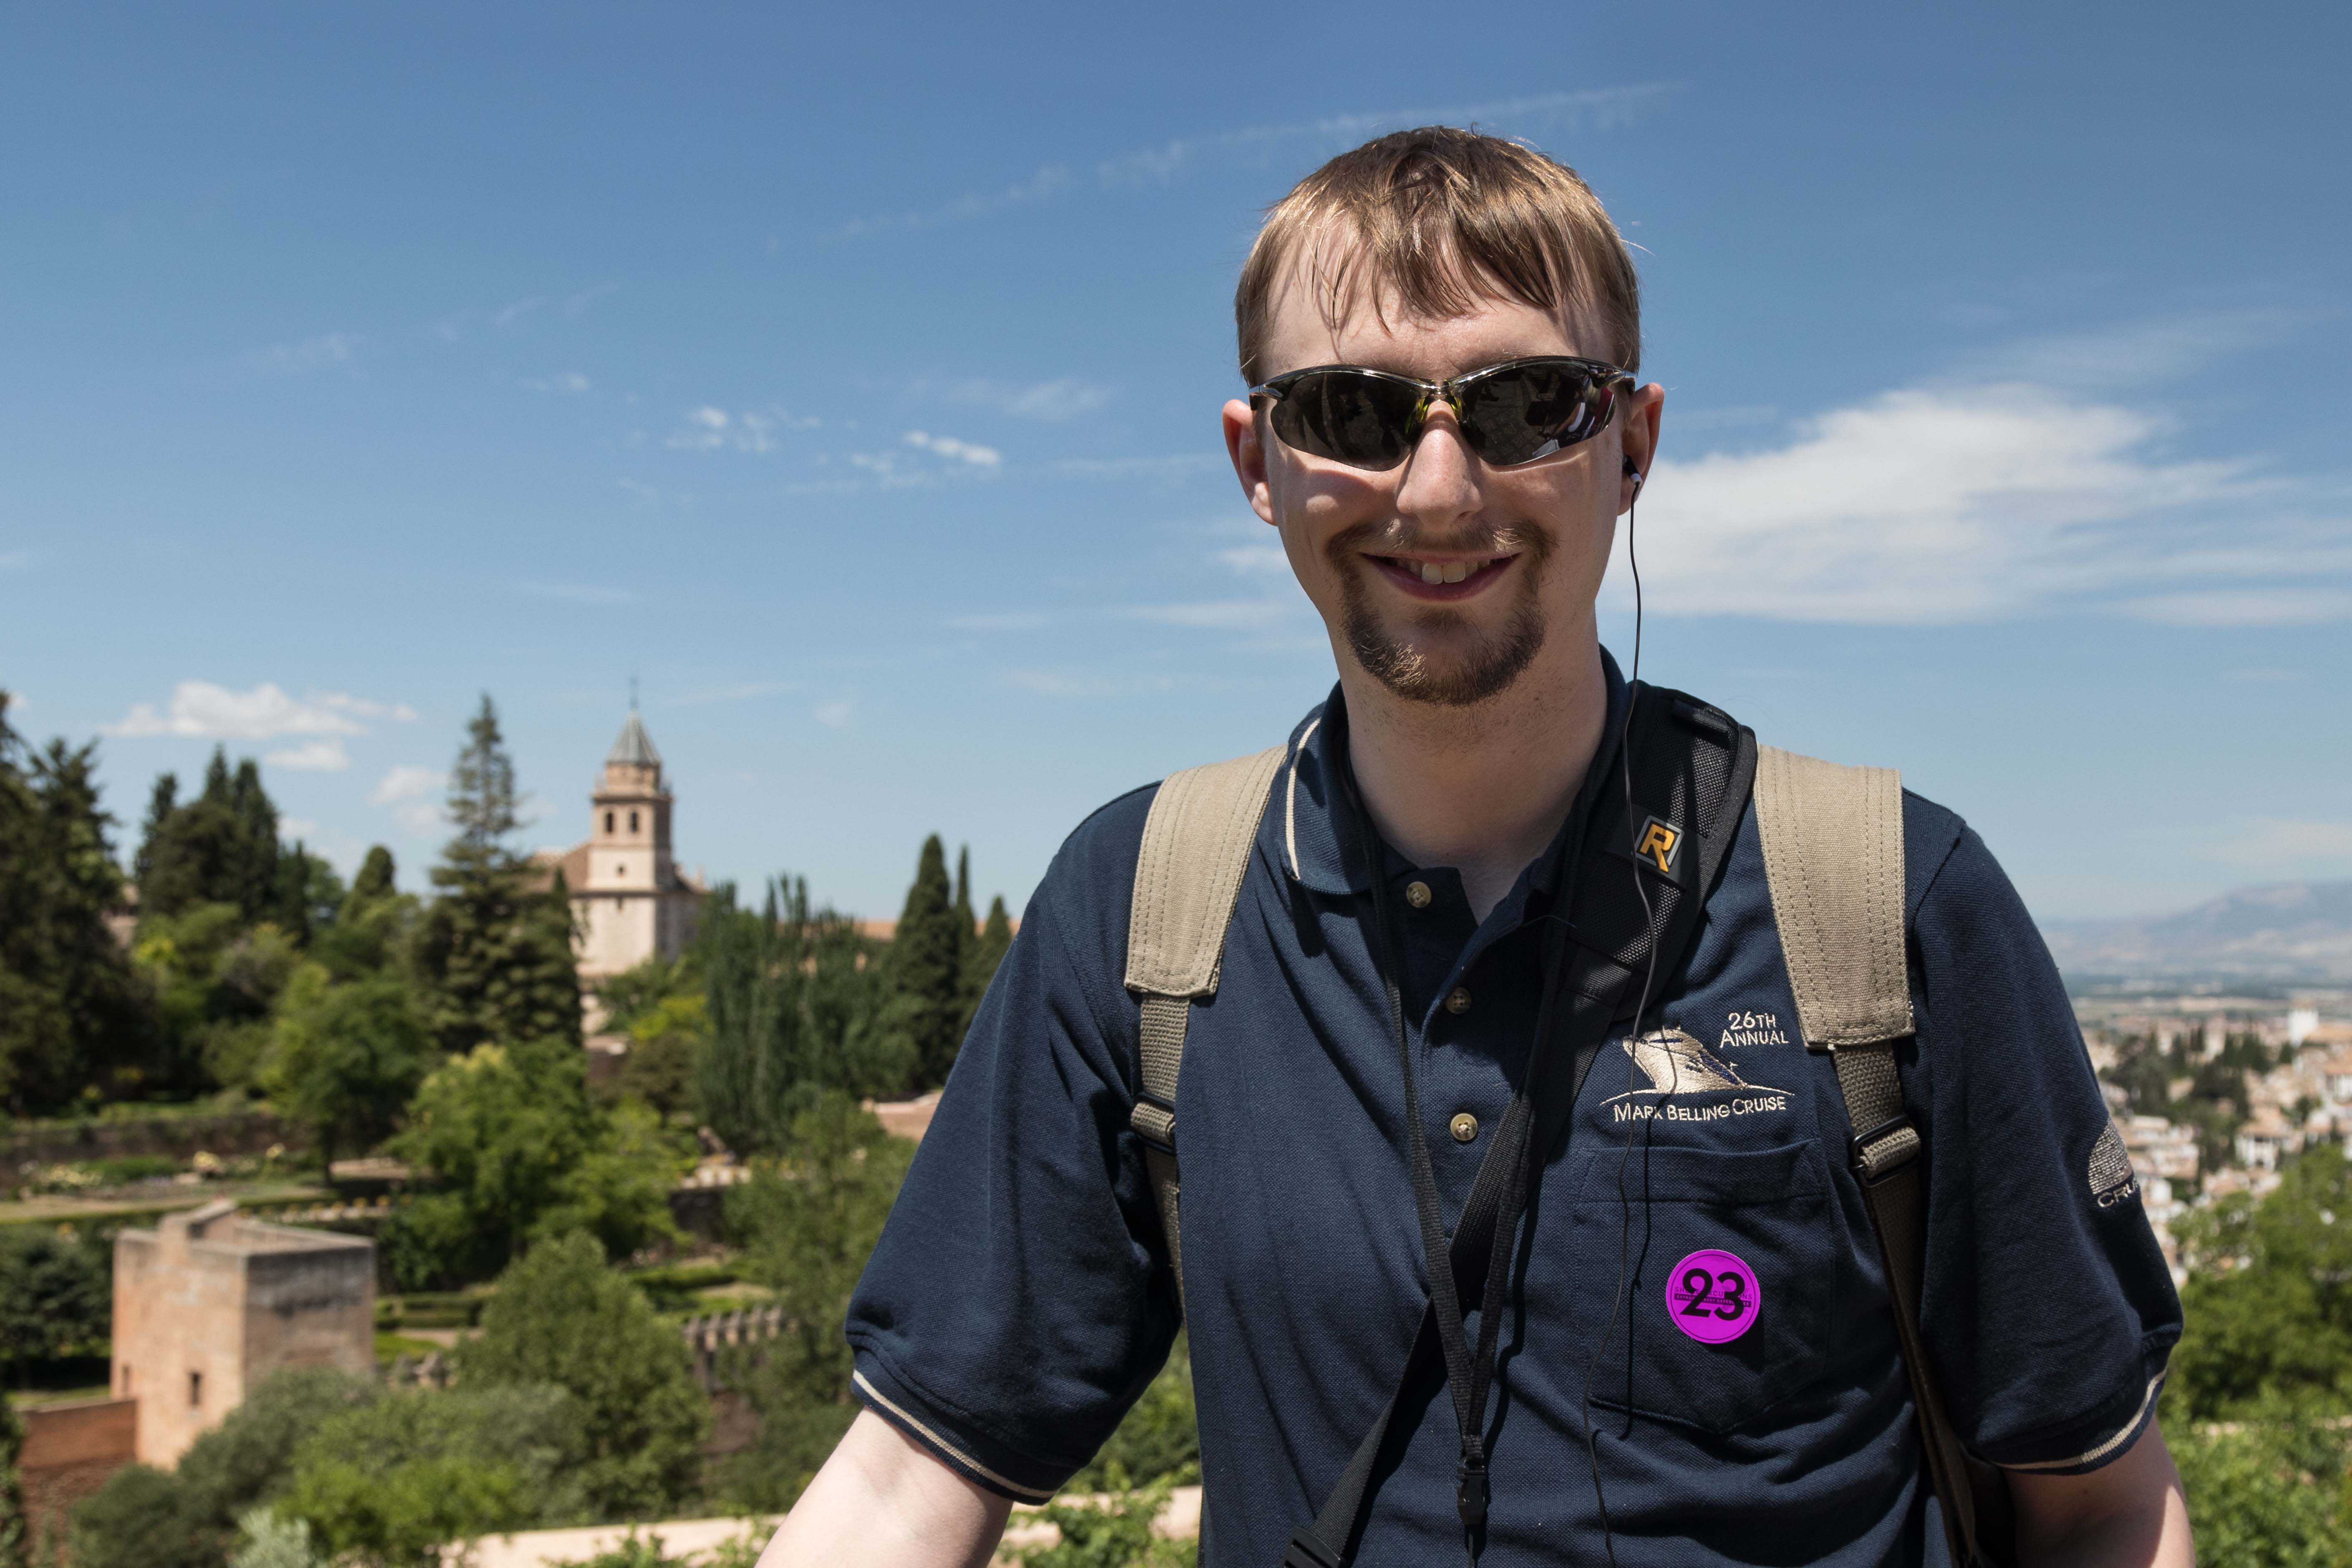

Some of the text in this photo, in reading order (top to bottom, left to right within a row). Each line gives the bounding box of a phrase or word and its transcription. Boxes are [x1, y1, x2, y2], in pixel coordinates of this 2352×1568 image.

[1640, 824, 1675, 872] R
[1728, 1011, 1776, 1030] 26TH
[1720, 1030, 1789, 1048] ANNUAL
[1614, 1096, 1786, 1122] MARK BELLING CRUISE
[2097, 1178, 2139, 1207] CRU
[1680, 1268, 1745, 1321] 23
